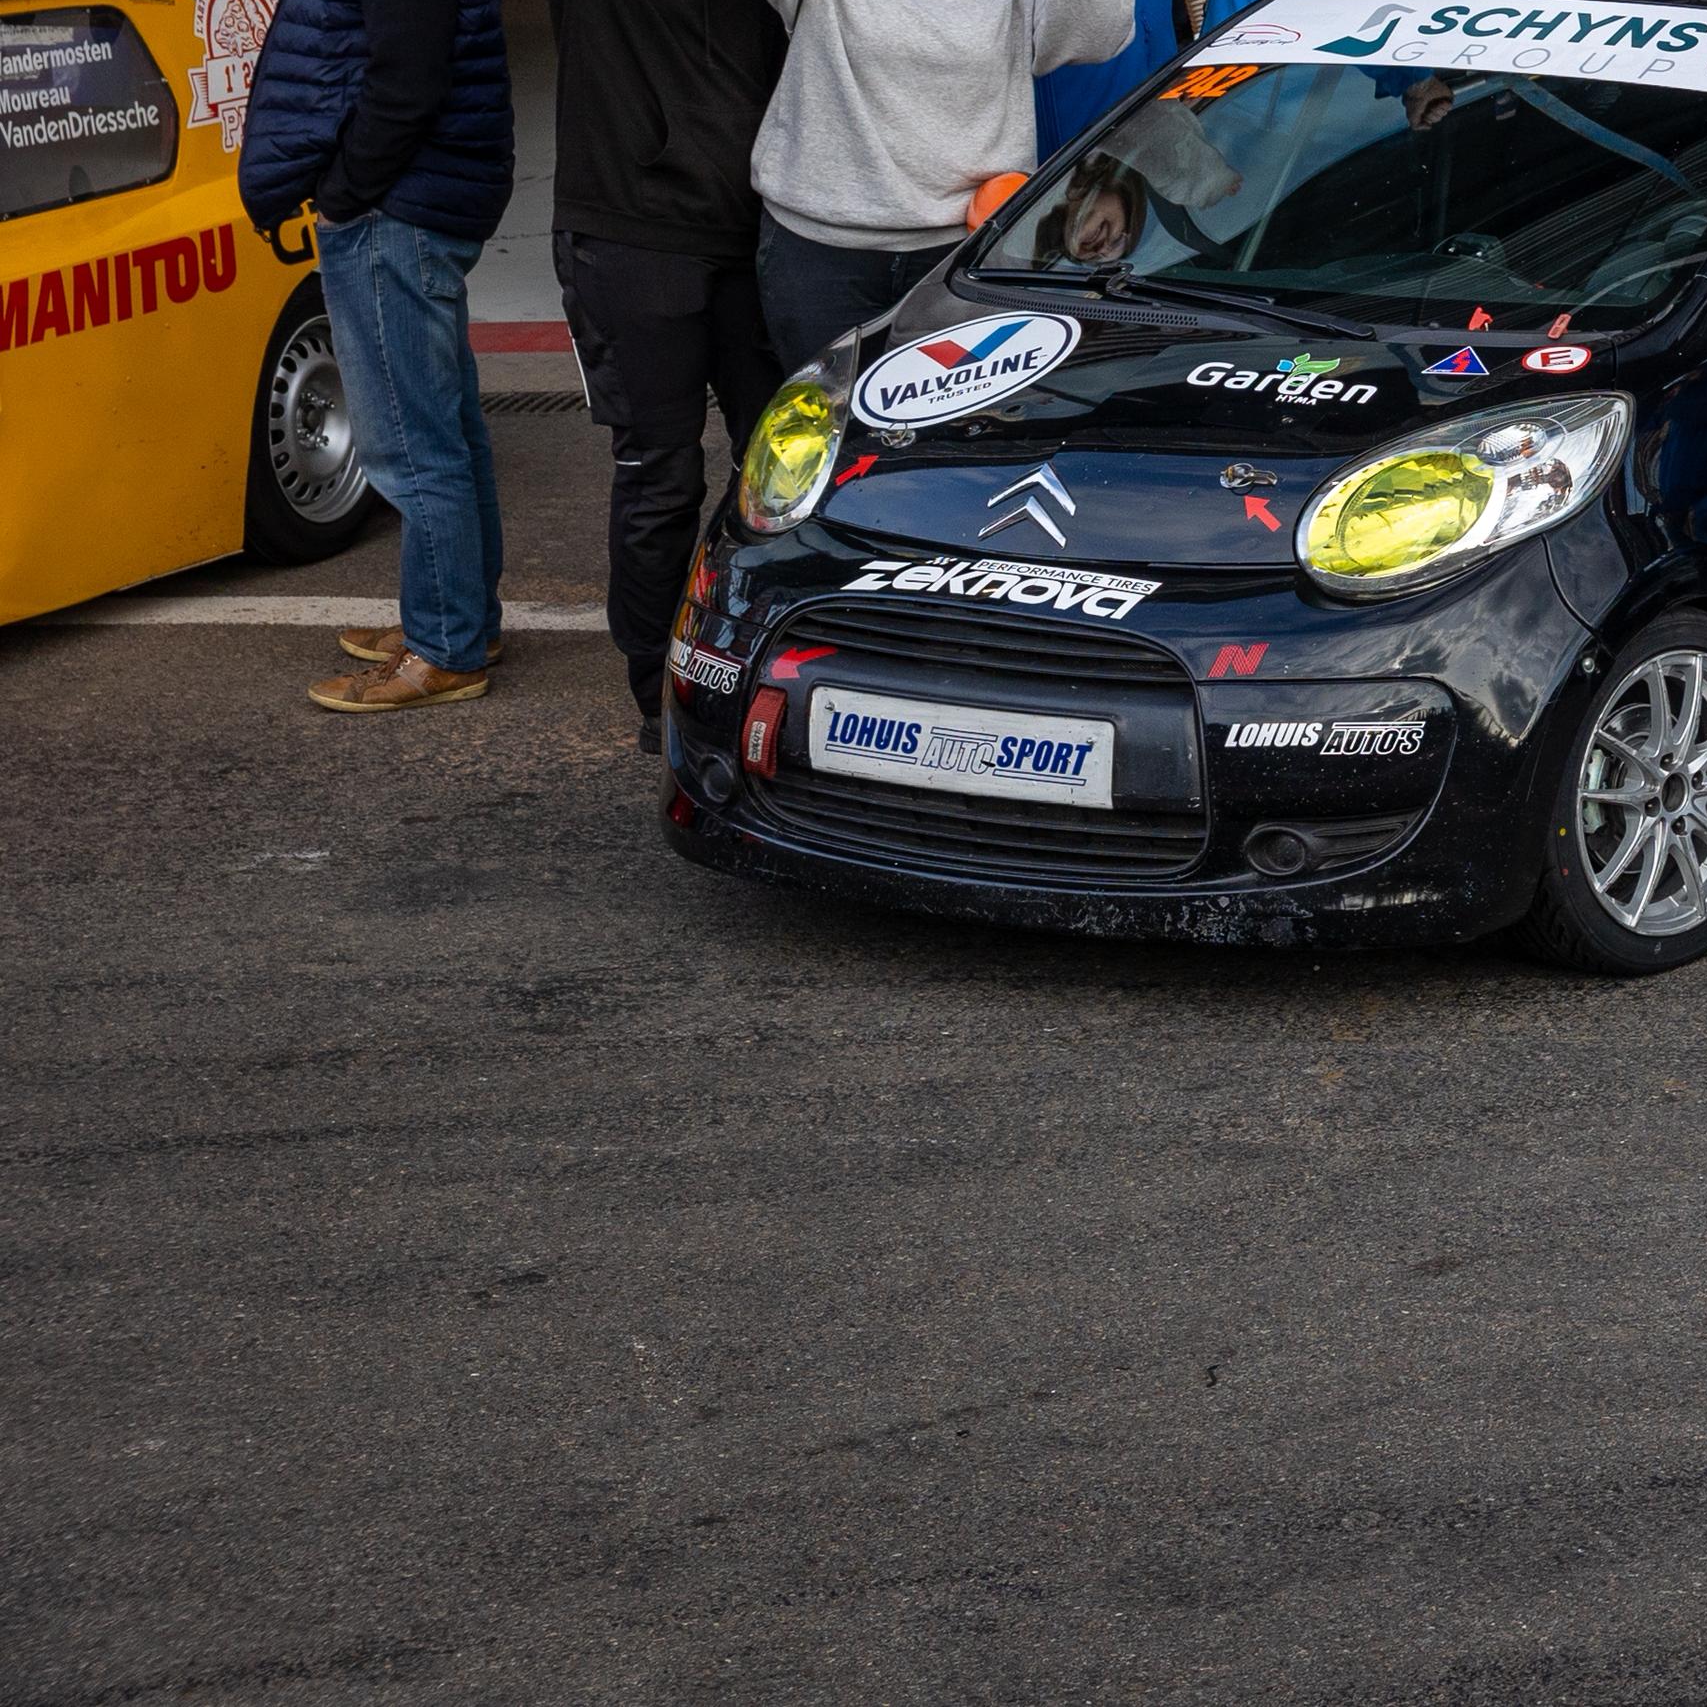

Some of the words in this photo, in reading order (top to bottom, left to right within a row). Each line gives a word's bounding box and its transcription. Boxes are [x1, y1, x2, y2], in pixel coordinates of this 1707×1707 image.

[0, 40, 113, 76] andermosten
[1391, 41, 1677, 81] GROUP
[0, 87, 71, 115] Moureau
[0, 100, 161, 149] VandenDriessche
[0, 222, 237, 352] MANITOU
[1540, 349, 1575, 368] E
[879, 346, 1044, 412] VALVOLINE
[928, 381, 992, 405] TRUSTED
[1186, 357, 1379, 405] Garden
[1274, 393, 1318, 406] HYMA
[977, 559, 1106, 586] PERFORMANCE
[1107, 577, 1153, 593] TIRES
[686, 655, 740, 694] AUTO'S
[826, 710, 922, 755] LOHUIS
[921, 735, 995, 775] AUTO
[996, 735, 1094, 777] SPORT
[1224, 722, 1323, 748] LOHUIS
[1320, 727, 1426, 756] AUTO'S
